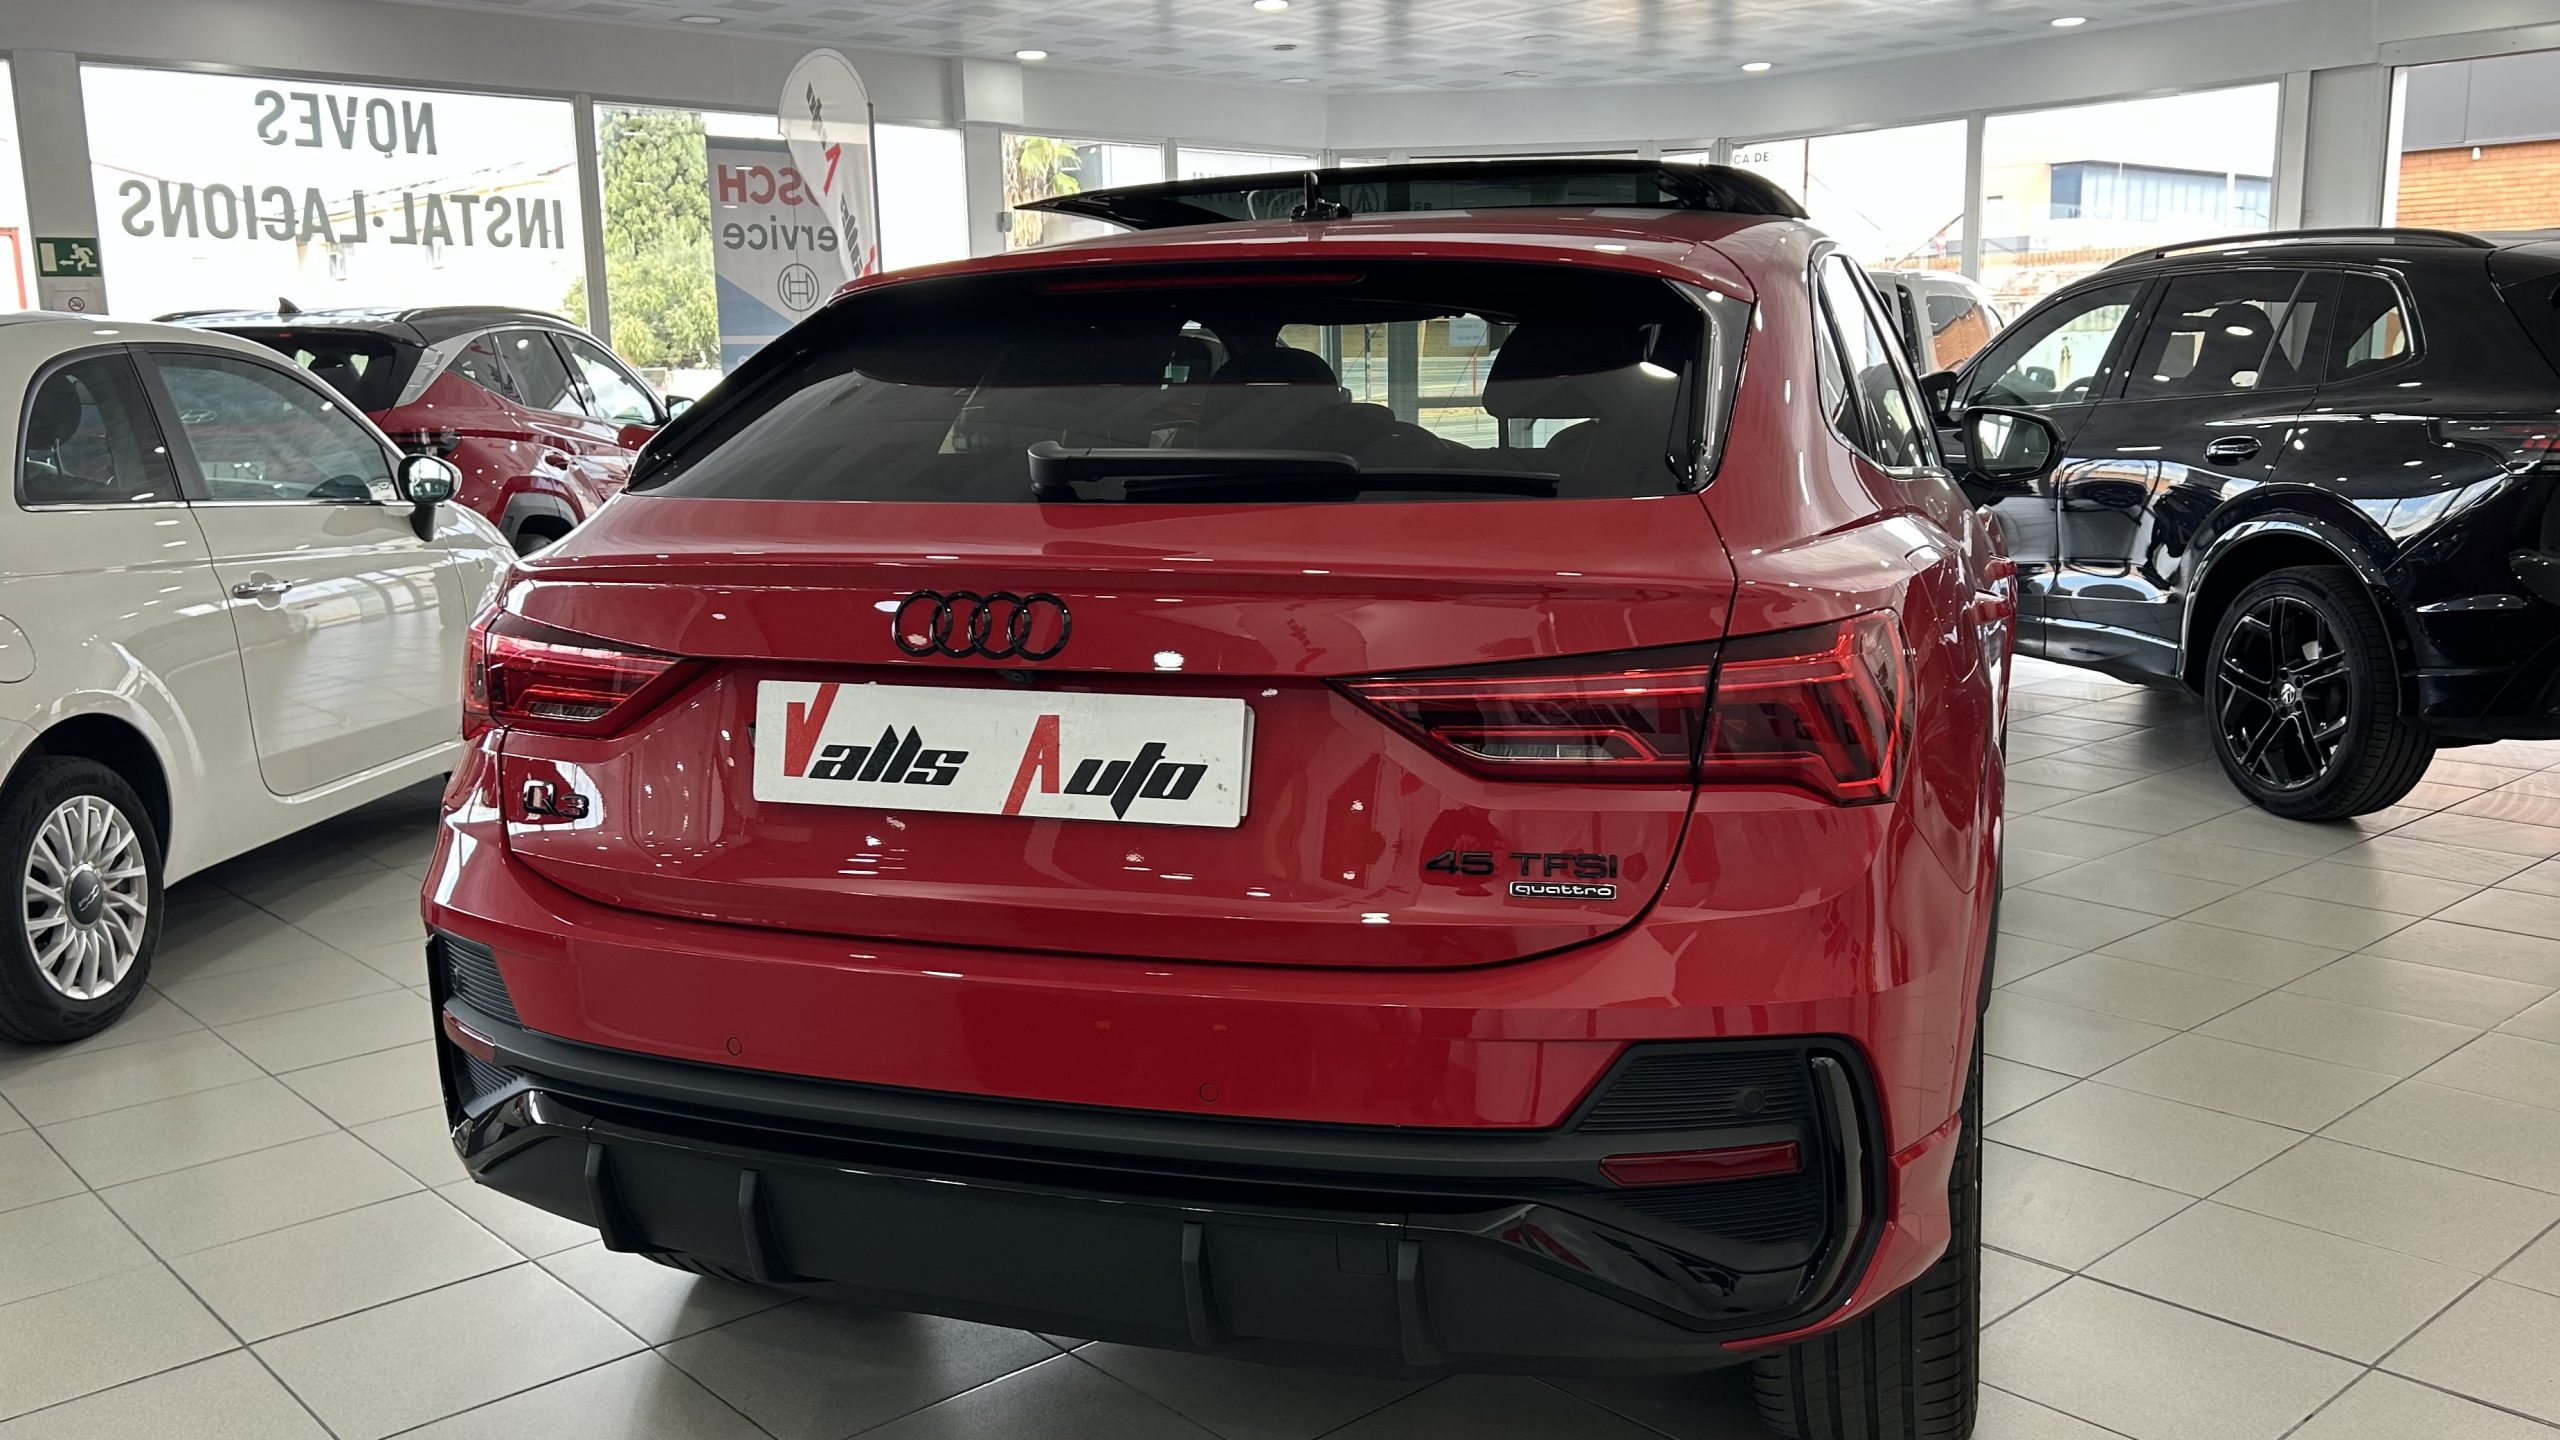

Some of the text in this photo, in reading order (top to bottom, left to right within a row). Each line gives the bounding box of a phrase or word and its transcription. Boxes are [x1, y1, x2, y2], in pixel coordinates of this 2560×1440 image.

[783, 682, 1208, 820] Valls Auto
[523, 779, 590, 819] Q3
[1424, 850, 1618, 879] 45 TFSI
[1514, 882, 1612, 897] quattro
